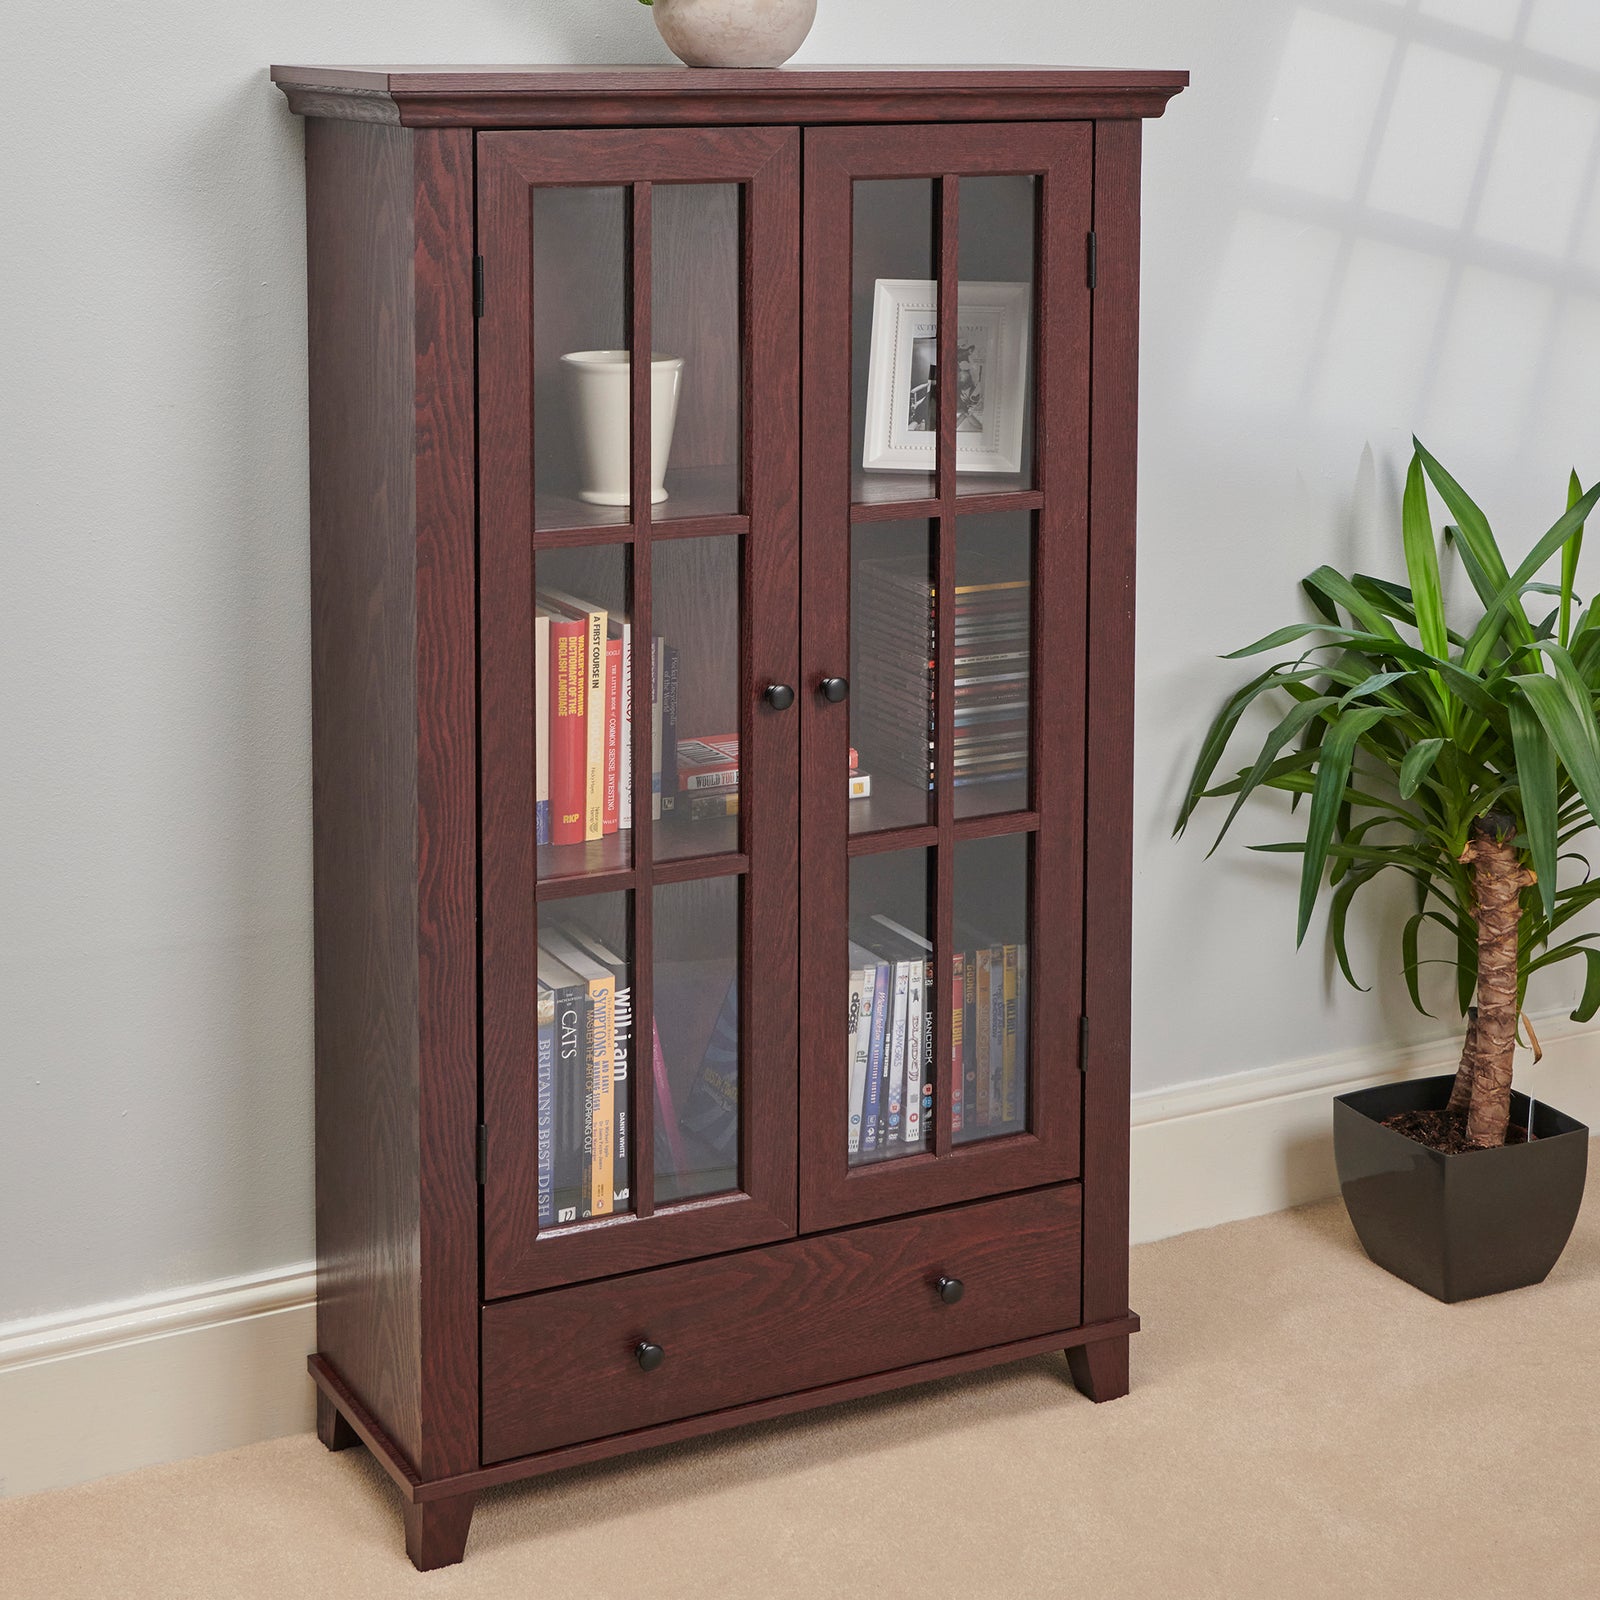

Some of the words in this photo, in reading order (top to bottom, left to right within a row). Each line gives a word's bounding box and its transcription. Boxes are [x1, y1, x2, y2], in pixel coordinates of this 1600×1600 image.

[559, 637, 568, 672] ENGLISH
[569, 636, 577, 686] DICTIONARY
[592, 647, 600, 677] COURSE
[558, 674, 568, 717] LANGUAGE
[569, 686, 576, 698] OF
[592, 680, 599, 689] IN
[609, 718, 617, 746] COMMON
[608, 774, 616, 810] INVESTING
[695, 774, 720, 788] WOULD
[721, 771, 734, 784] YOU
[586, 1009, 594, 1044] MASTER
[592, 988, 609, 1058] SYMPTOMS
[848, 991, 861, 1034] dogs
[561, 1010, 577, 1059] CATS
[614, 986, 632, 1081] will.i.am
[925, 1011, 933, 1065] HANCOCK
[856, 1050, 868, 1063] elf
[539, 1038, 551, 1126] BRITAIN'S
[586, 1080, 593, 1092] OF
[593, 1061, 601, 1091] WARNING
[584, 1092, 593, 1135] WORKING
[592, 1092, 601, 1112] SIGNS
[538, 1129, 551, 1170] BEST
[584, 1136, 592, 1154] OUT
[538, 1174, 550, 1217] DISH
